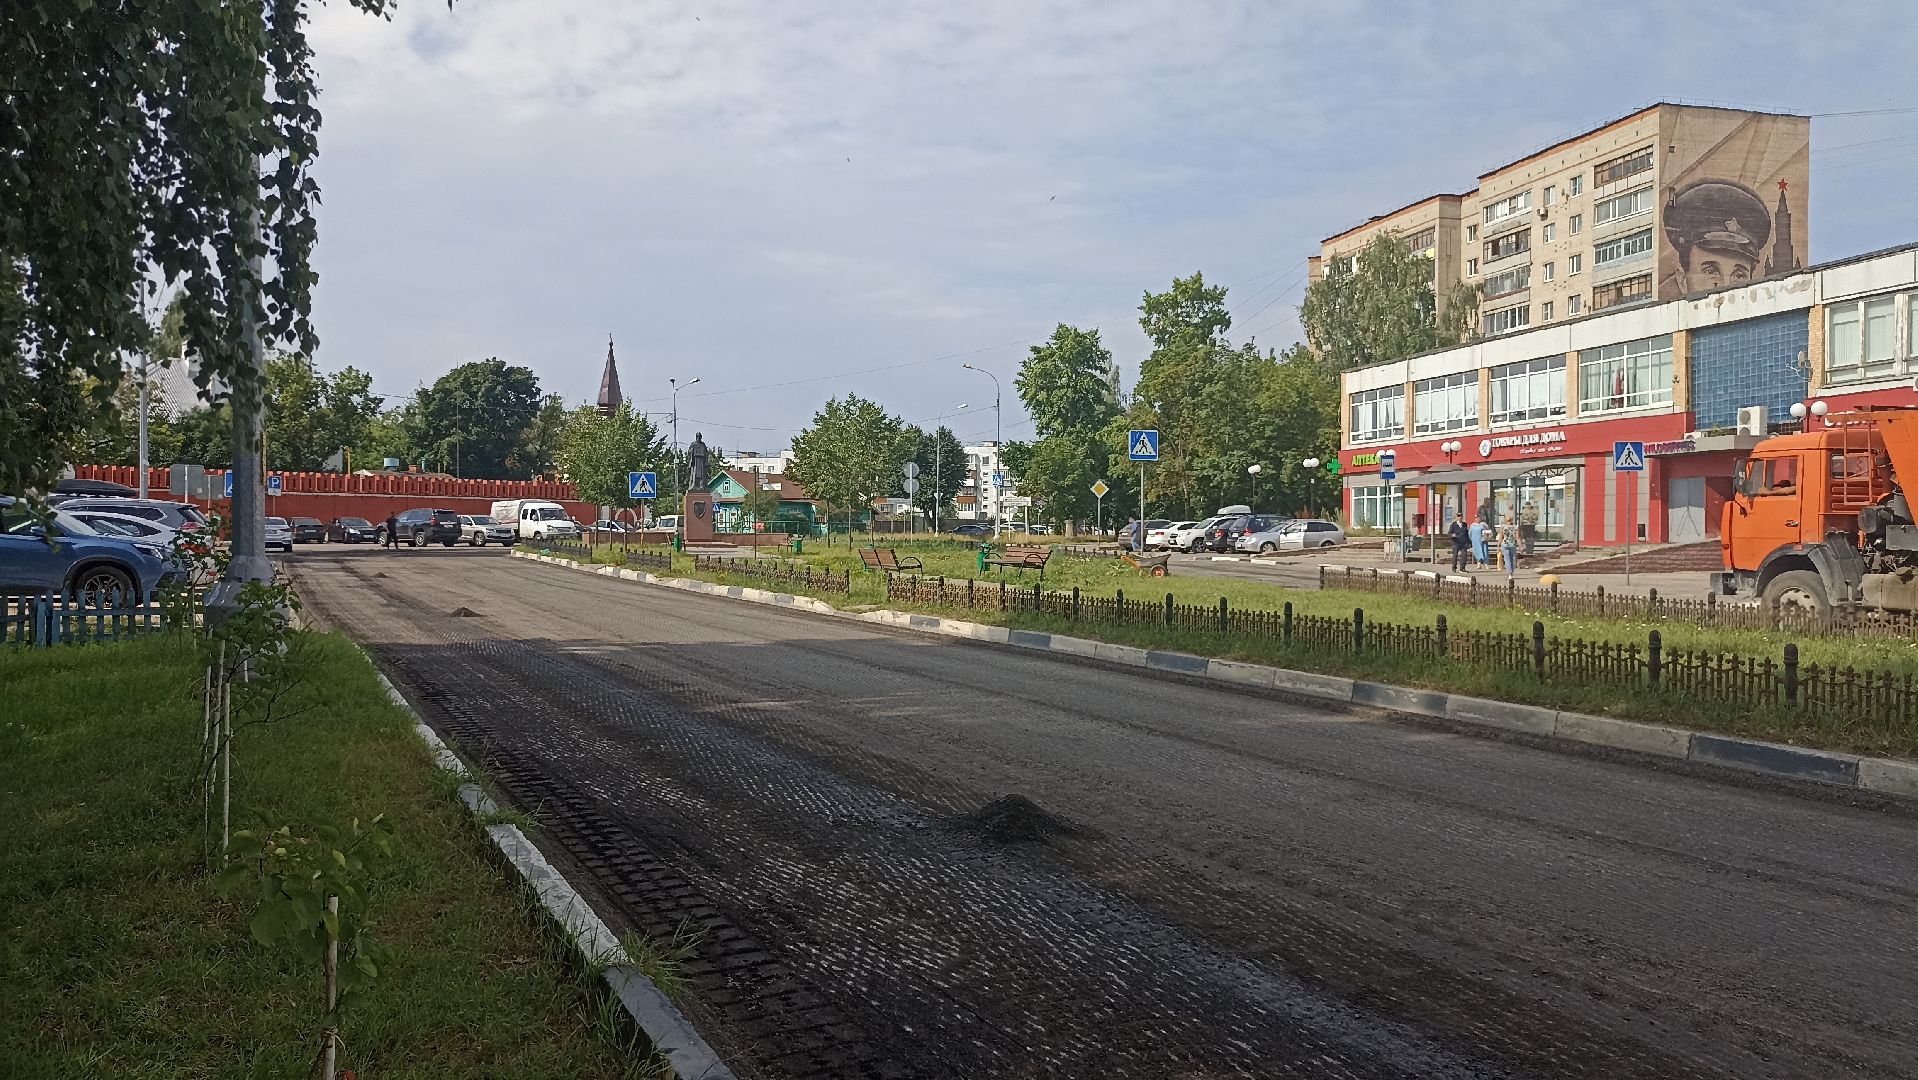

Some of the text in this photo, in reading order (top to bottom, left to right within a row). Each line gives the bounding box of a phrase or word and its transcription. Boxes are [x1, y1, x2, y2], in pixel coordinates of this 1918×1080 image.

[1491, 431, 1566, 448] ТОВАРЫ ДЛЯ ДОМА
[272, 478, 280, 488] P
